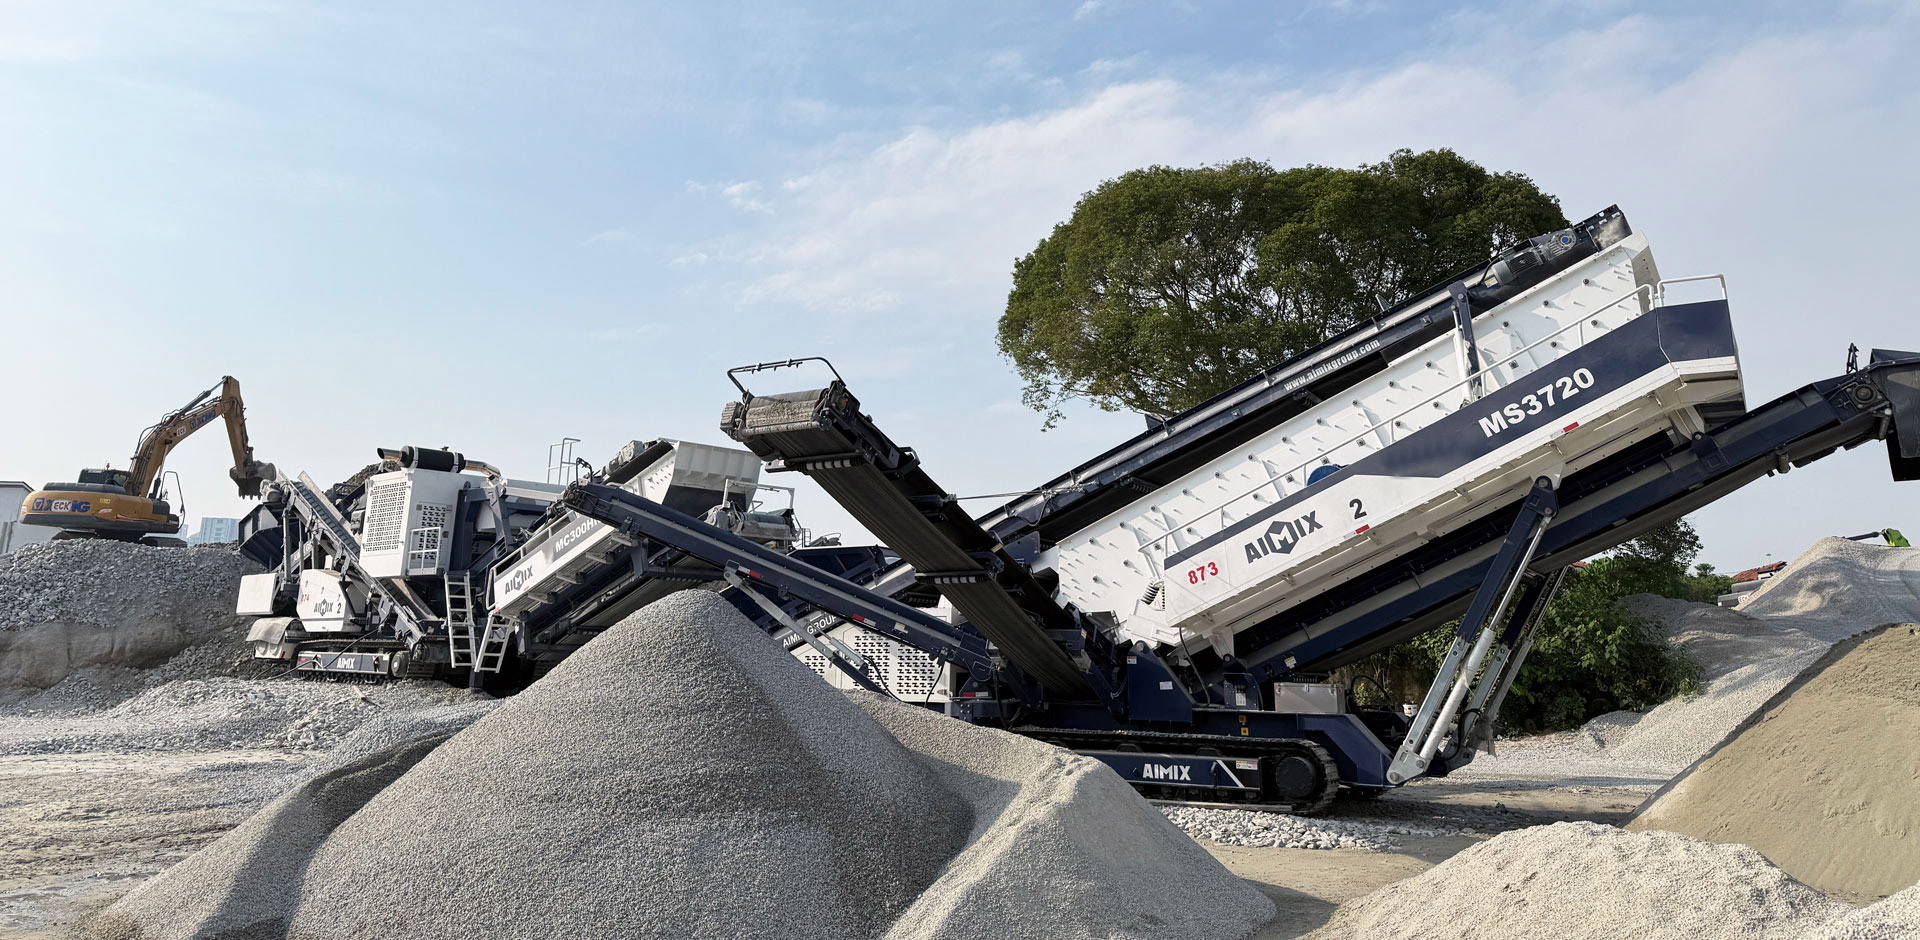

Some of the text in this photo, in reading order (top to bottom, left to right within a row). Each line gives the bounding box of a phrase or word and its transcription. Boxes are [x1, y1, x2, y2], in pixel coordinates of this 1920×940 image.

[1284, 340, 1380, 391] www.aimixgroup.com
[1478, 367, 1595, 438] MS3720
[53, 501, 71, 511] ECK
[1349, 499, 1367, 519] 2
[1244, 510, 1324, 564] AIMIX
[505, 565, 533, 595] AIMIX
[1187, 562, 1218, 584] 873
[337, 603, 341, 613] 2
[336, 657, 355, 669] AIMIX
[1142, 763, 1191, 781] AIMIX
